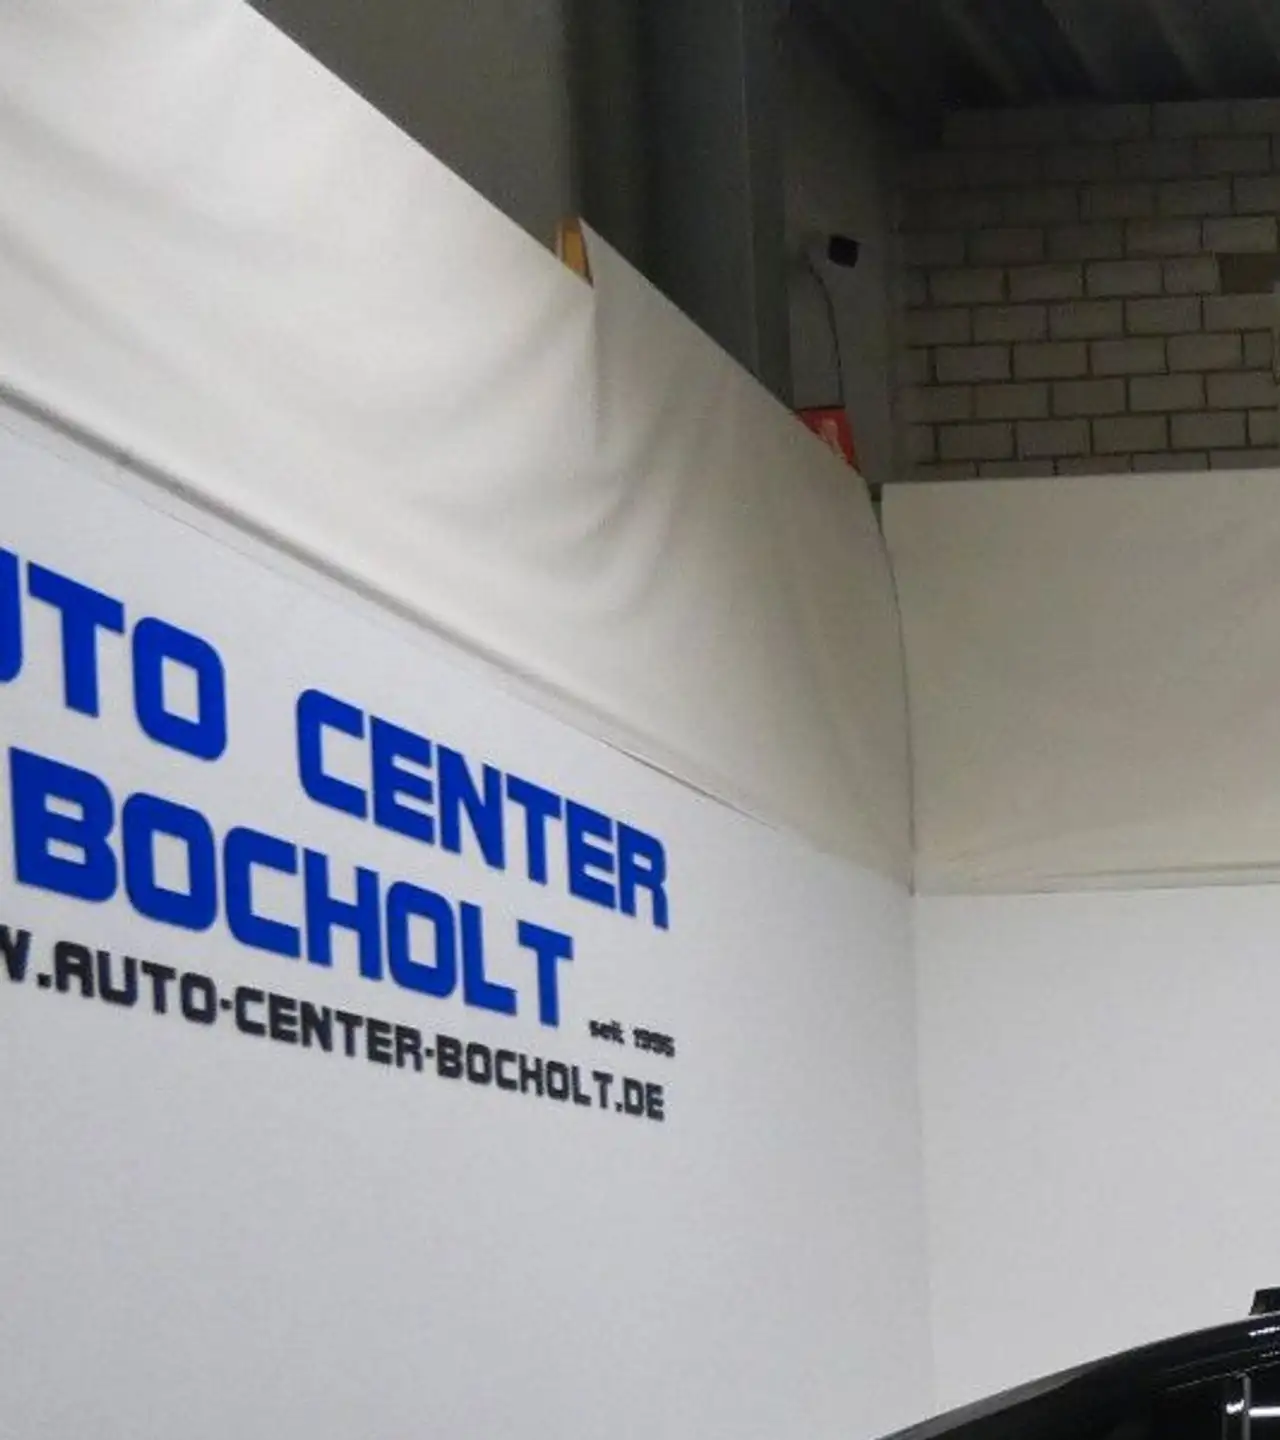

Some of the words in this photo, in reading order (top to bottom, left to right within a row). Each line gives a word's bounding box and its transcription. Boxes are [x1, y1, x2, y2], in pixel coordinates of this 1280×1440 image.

[0, 548, 229, 761] TO
[296, 689, 670, 928] CENTER
[9, 747, 574, 1027] BOCHOLT
